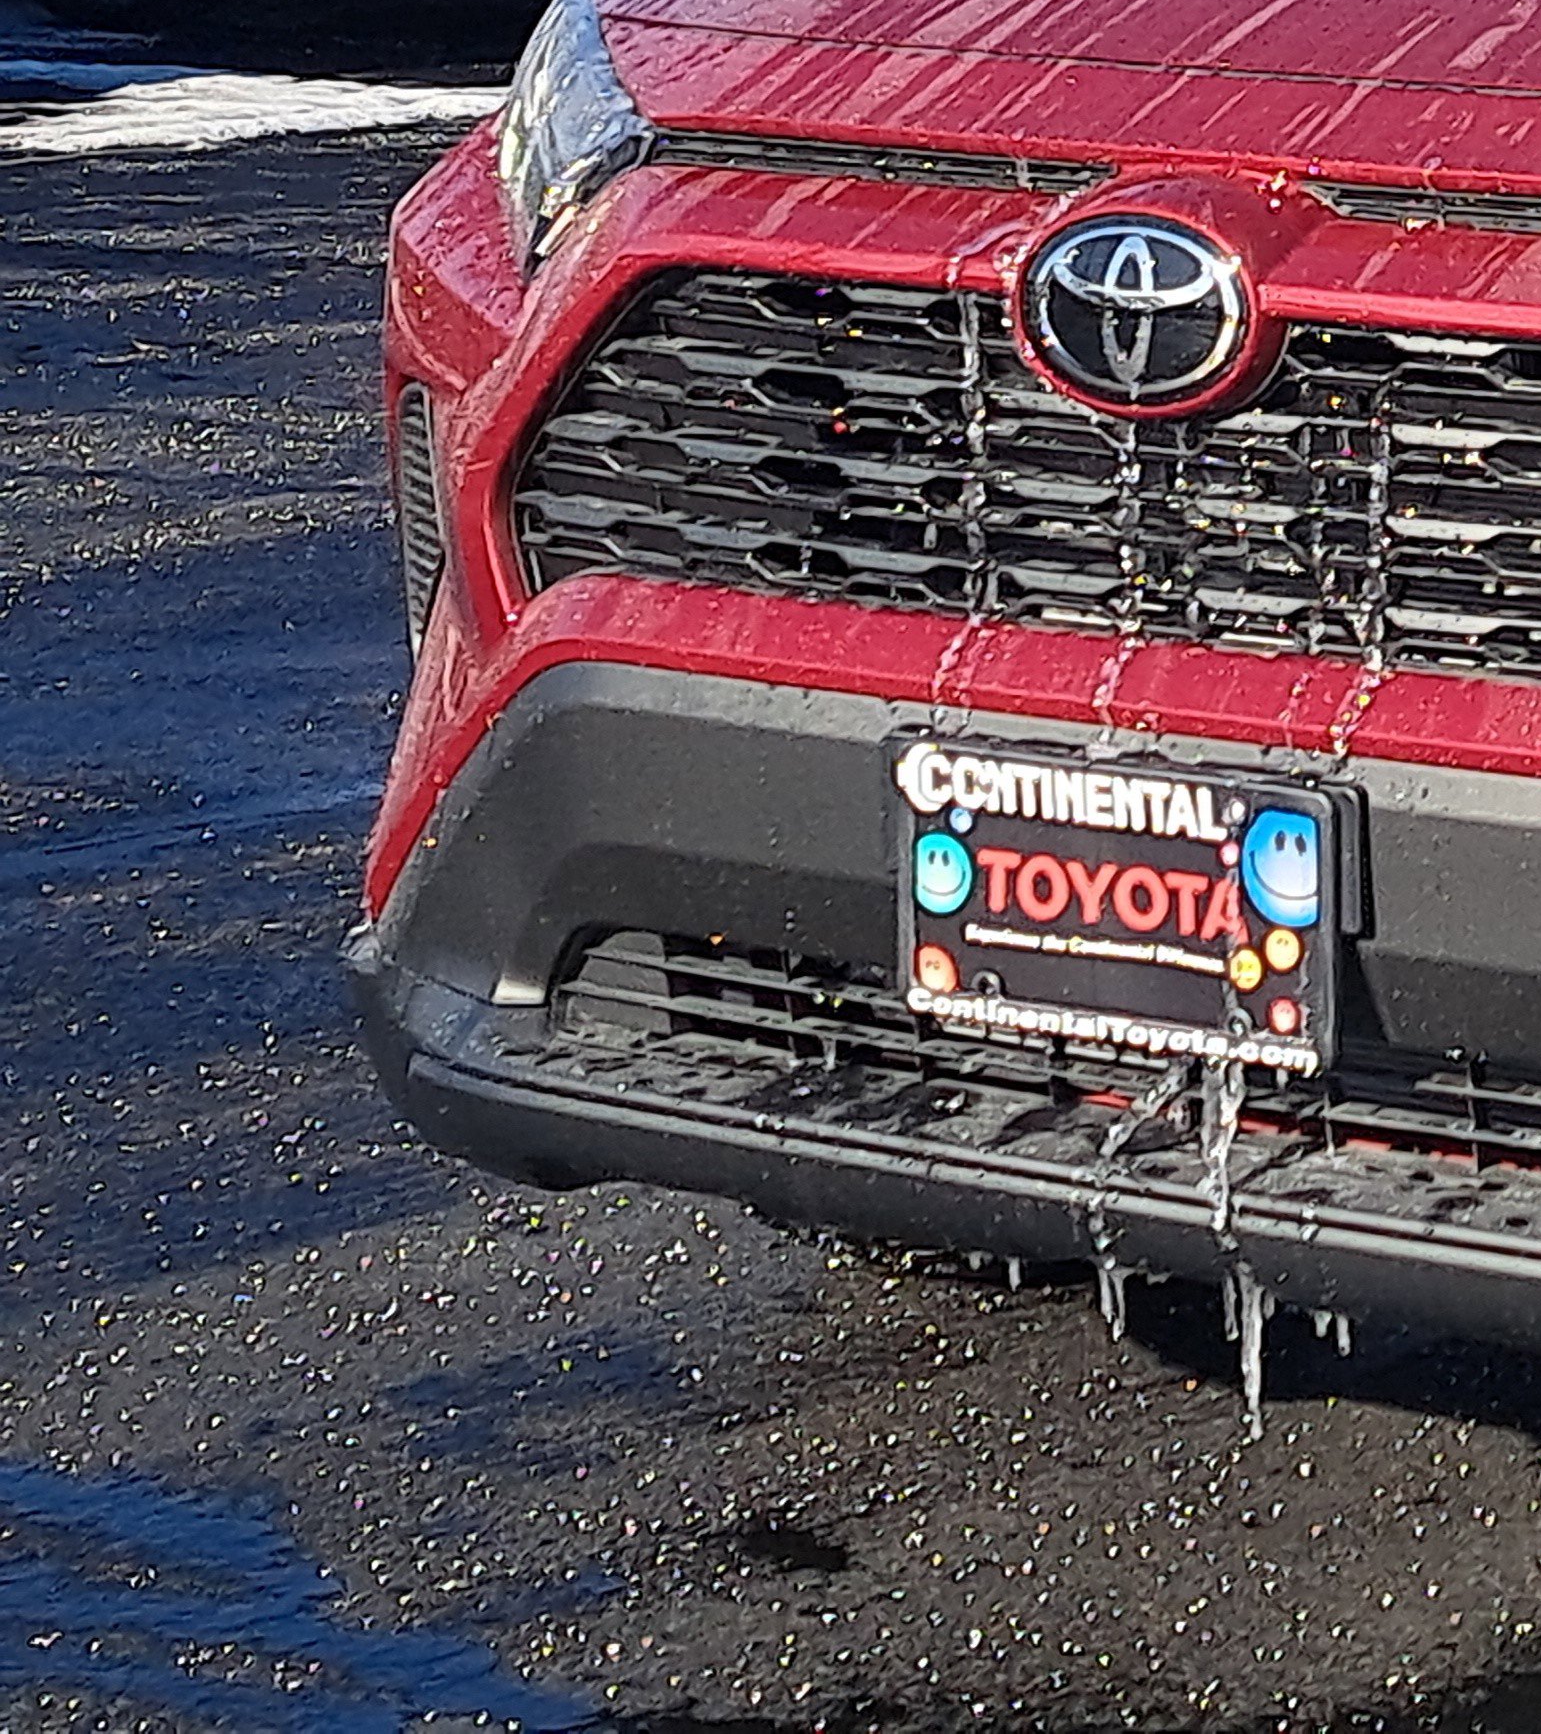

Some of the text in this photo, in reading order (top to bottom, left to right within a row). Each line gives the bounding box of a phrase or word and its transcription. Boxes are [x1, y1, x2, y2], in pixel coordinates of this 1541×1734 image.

[898, 742, 1228, 841] CONTINENTAL
[976, 846, 1250, 946] TOYOTA
[906, 987, 1318, 1075] ContinentalToyota.com
